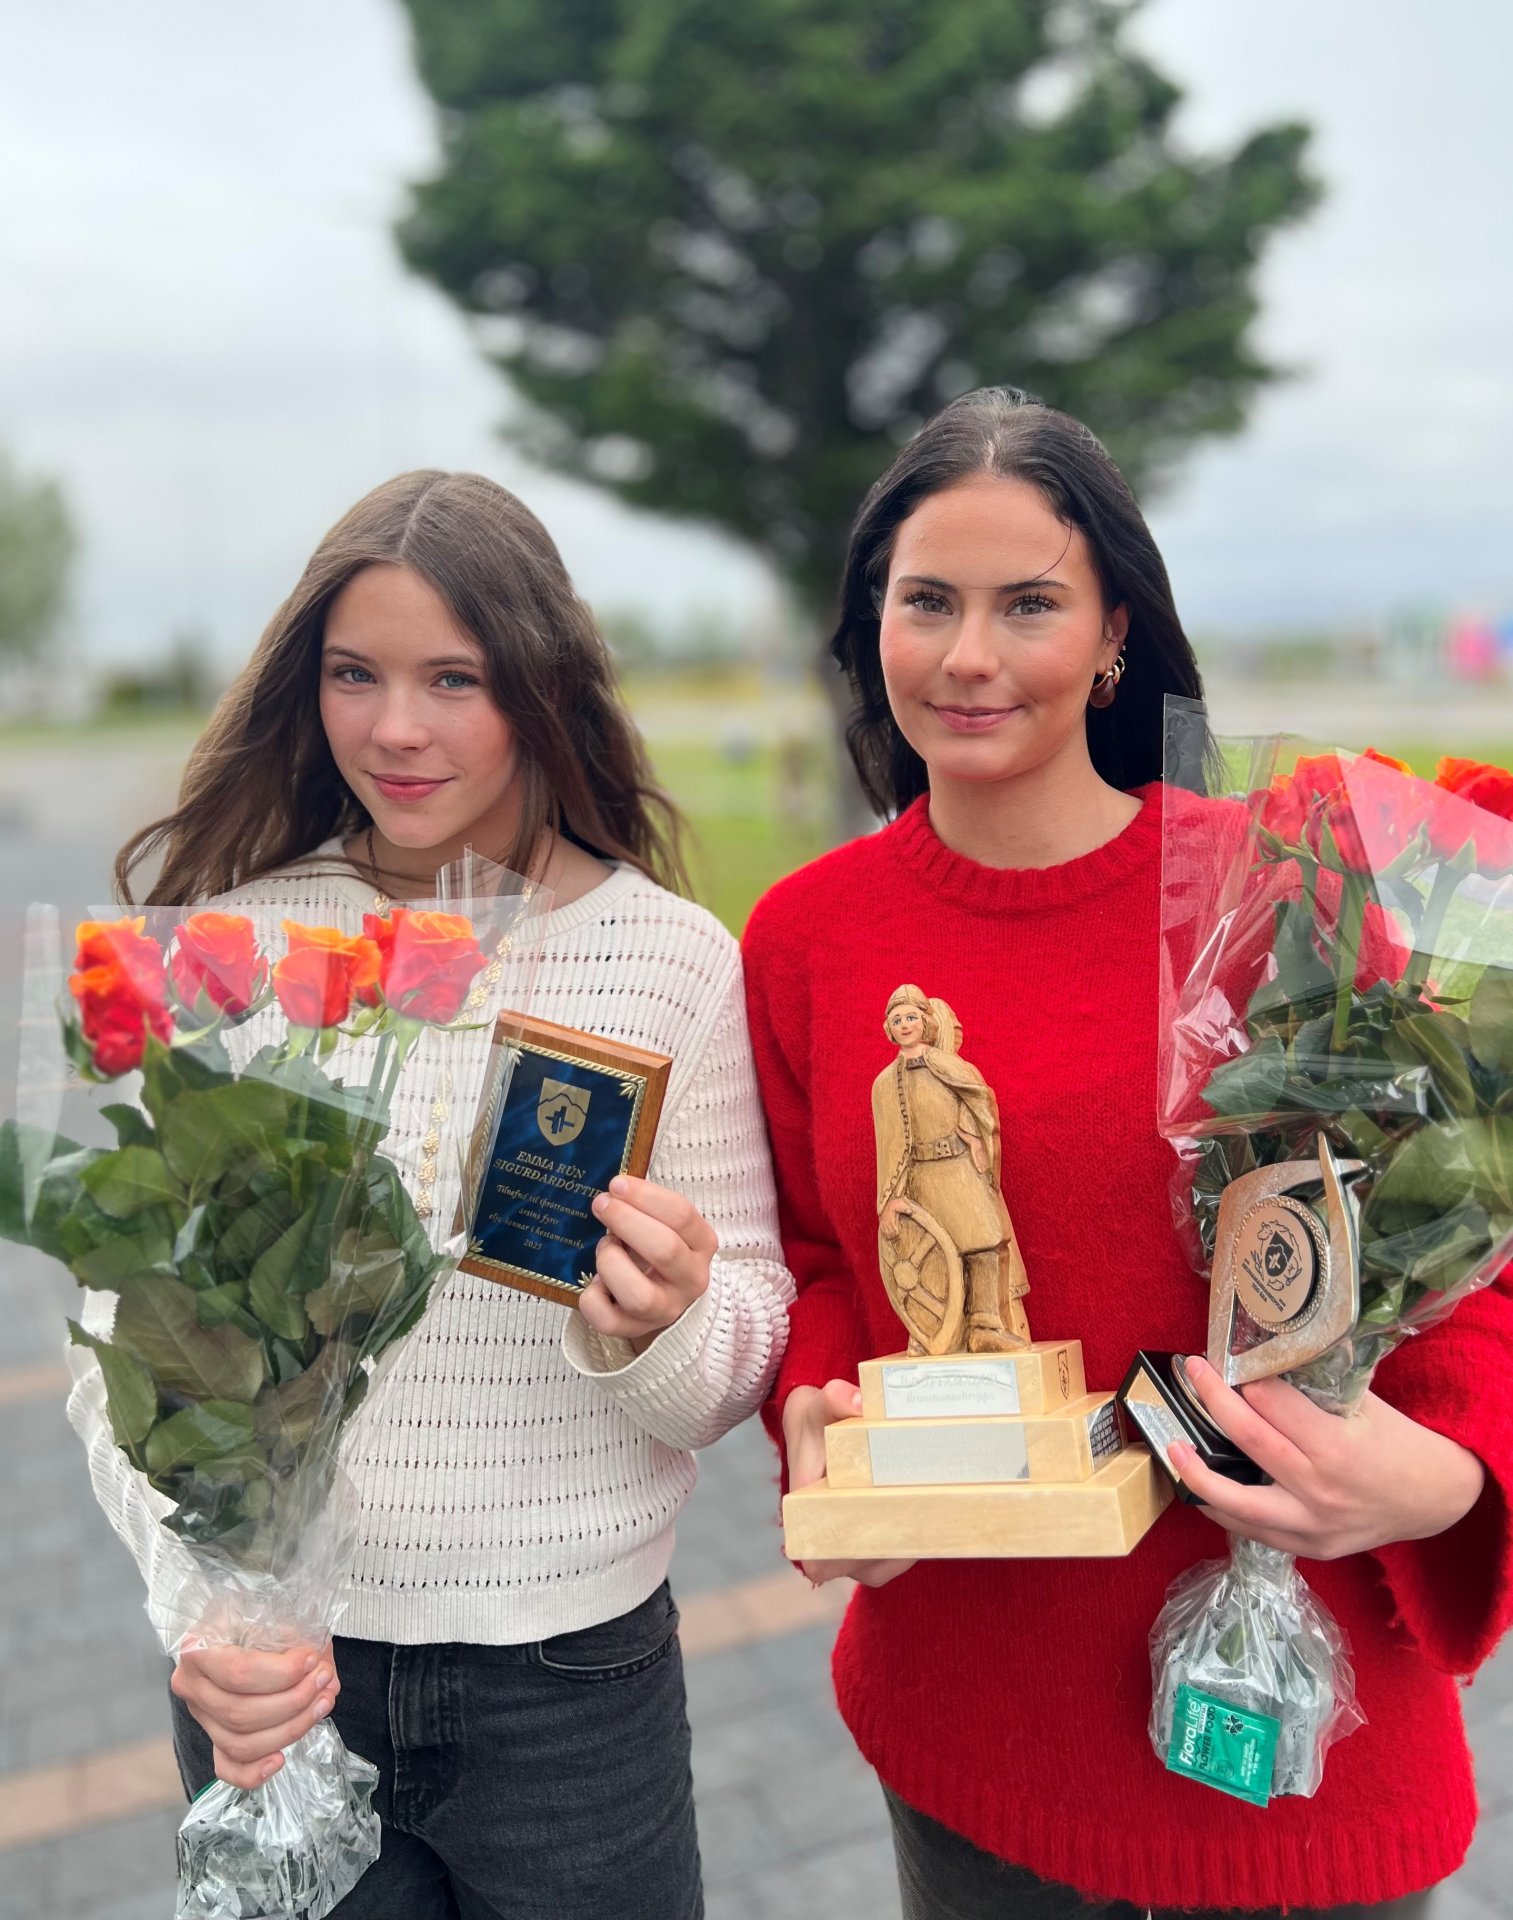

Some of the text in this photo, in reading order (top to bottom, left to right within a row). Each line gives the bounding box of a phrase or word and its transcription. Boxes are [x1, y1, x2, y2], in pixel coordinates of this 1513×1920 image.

[516, 1151, 586, 1179] EMMA RÚN
[496, 1184, 529, 1200] Tilnefnd
[529, 1193, 538, 1203] til
[1200, 1706, 1216, 1769] FLOWER FOOD
